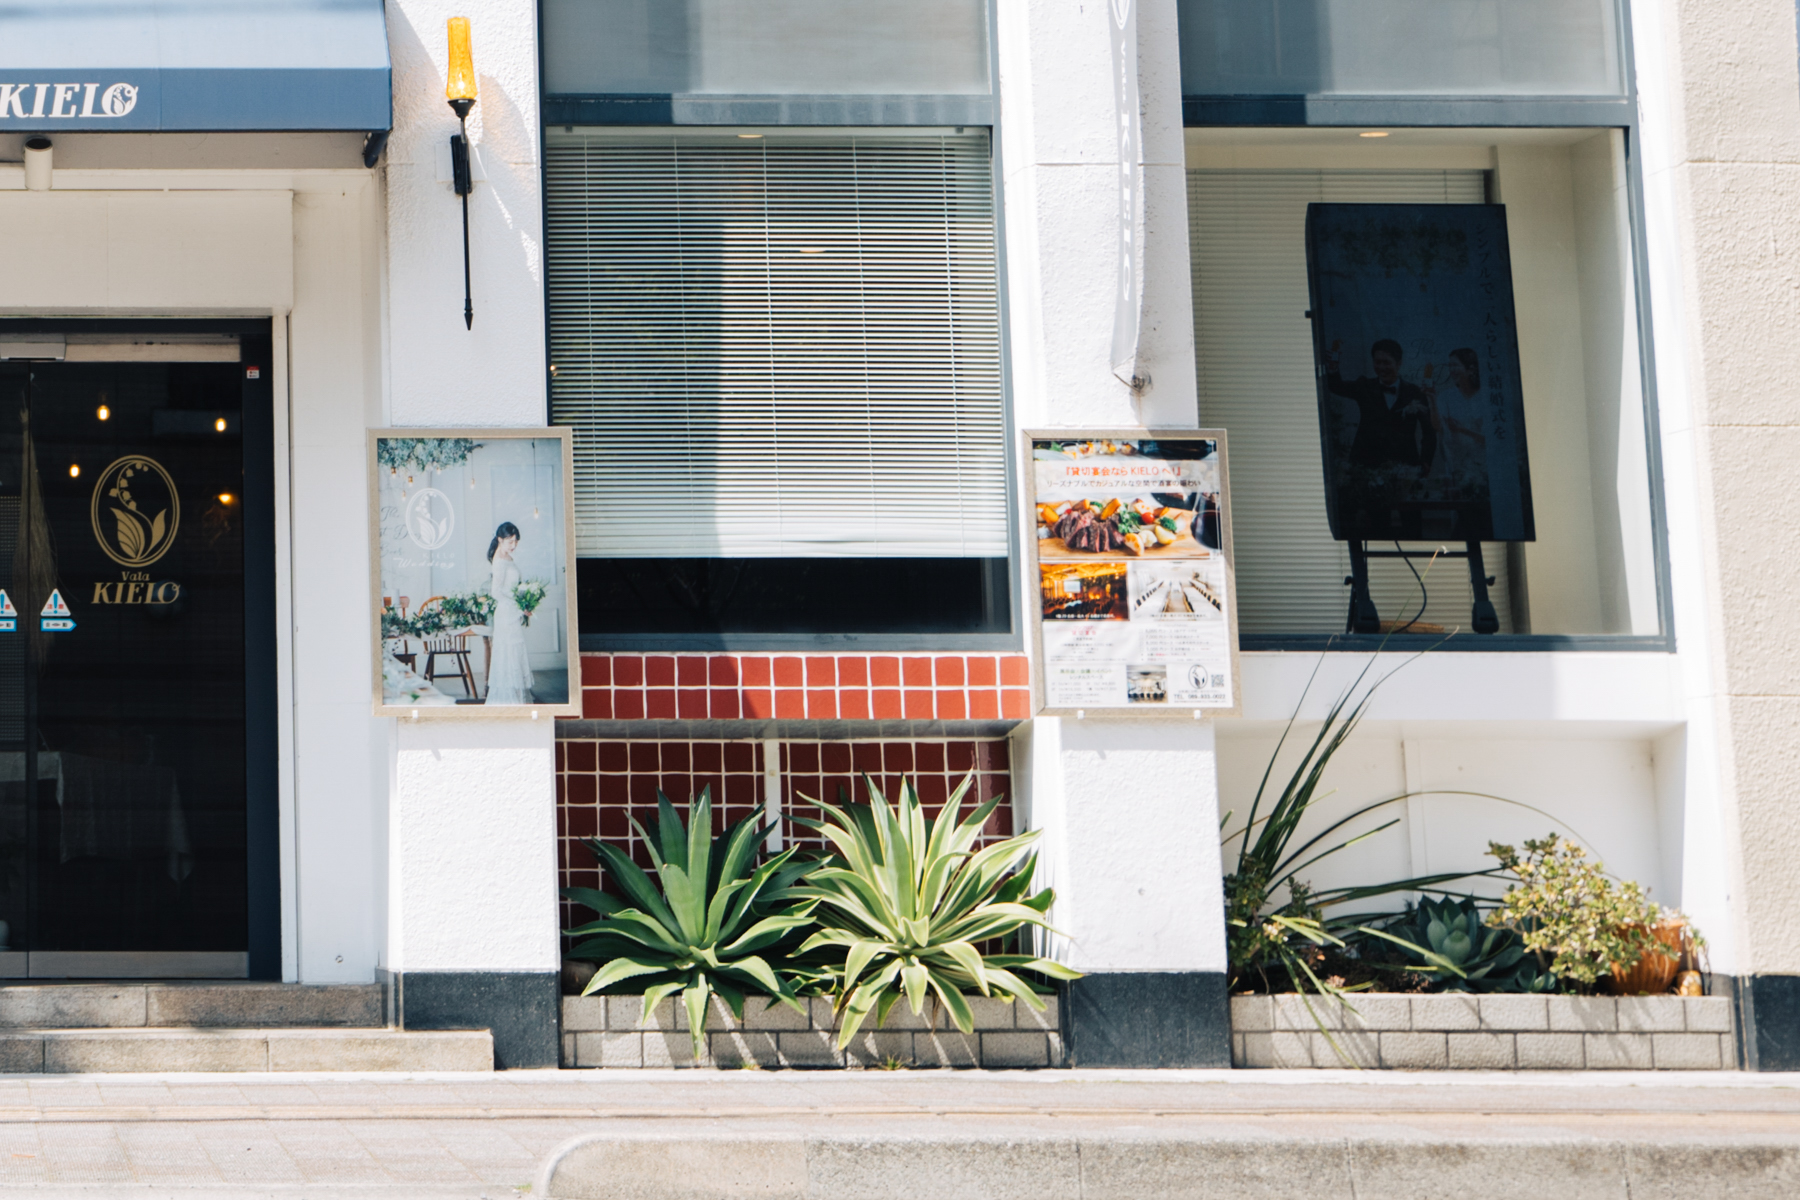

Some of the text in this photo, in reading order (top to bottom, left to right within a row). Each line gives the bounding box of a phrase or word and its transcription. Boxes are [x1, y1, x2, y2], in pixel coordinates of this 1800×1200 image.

[1130, 466, 1159, 476] KIELO
[121, 571, 150, 581] Vala
[91, 581, 180, 604] KIELO
